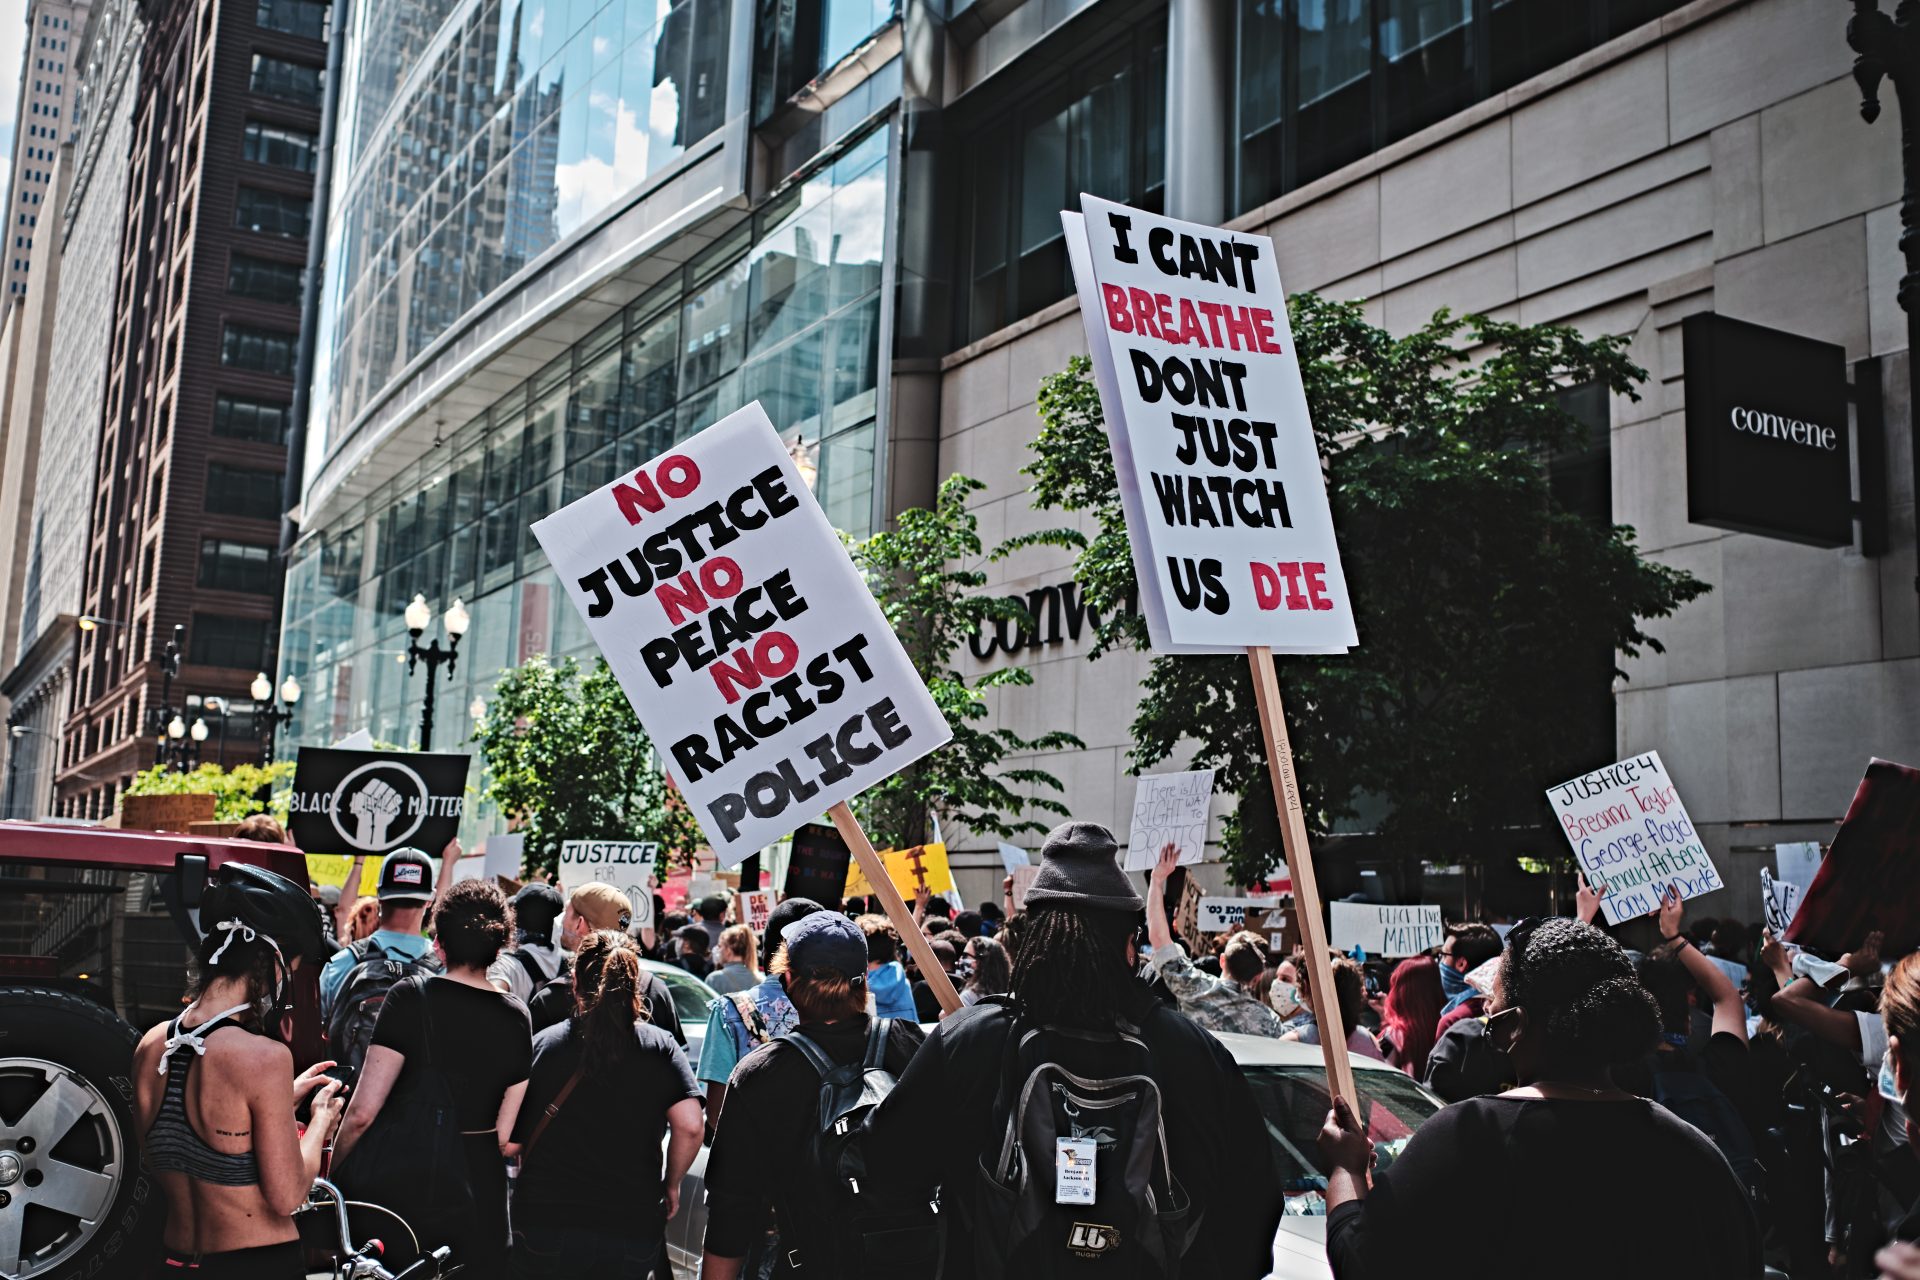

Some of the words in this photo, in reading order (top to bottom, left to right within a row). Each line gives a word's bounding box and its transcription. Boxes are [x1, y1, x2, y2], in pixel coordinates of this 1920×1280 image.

[1107, 212, 1138, 265] I
[1101, 282, 1282, 354] BREATHE
[1171, 412, 1278, 473] JUST
[1731, 406, 1836, 451] convene
[612, 454, 701, 526] NO
[1151, 471, 1293, 529] WATCH
[578, 465, 799, 619] JUSTICE
[655, 556, 744, 626] NO
[1167, 556, 1230, 615] US
[1249, 561, 1333, 611] DIE
[640, 568, 809, 689] PEACE
[709, 631, 800, 704] NO
[670, 633, 869, 783] RACIST
[706, 697, 912, 843] POLICE
[1637, 756, 1659, 774] 4
[289, 792, 343, 813] BLACK
[407, 796, 465, 817] MATTER
[1134, 799, 1184, 830] RIGHT
[1191, 809, 1204, 818] TO
[1625, 785, 1676, 815] Taylor
[562, 844, 655, 864] JUSTICE
[594, 865, 616, 881] FOR
[1581, 838, 1647, 871] George
[1649, 845, 1709, 876] Arbery
[1600, 891, 1650, 922] Tony
[1383, 925, 1440, 954] MATTER!
[1075, 1251, 1101, 1259] RUGBY
